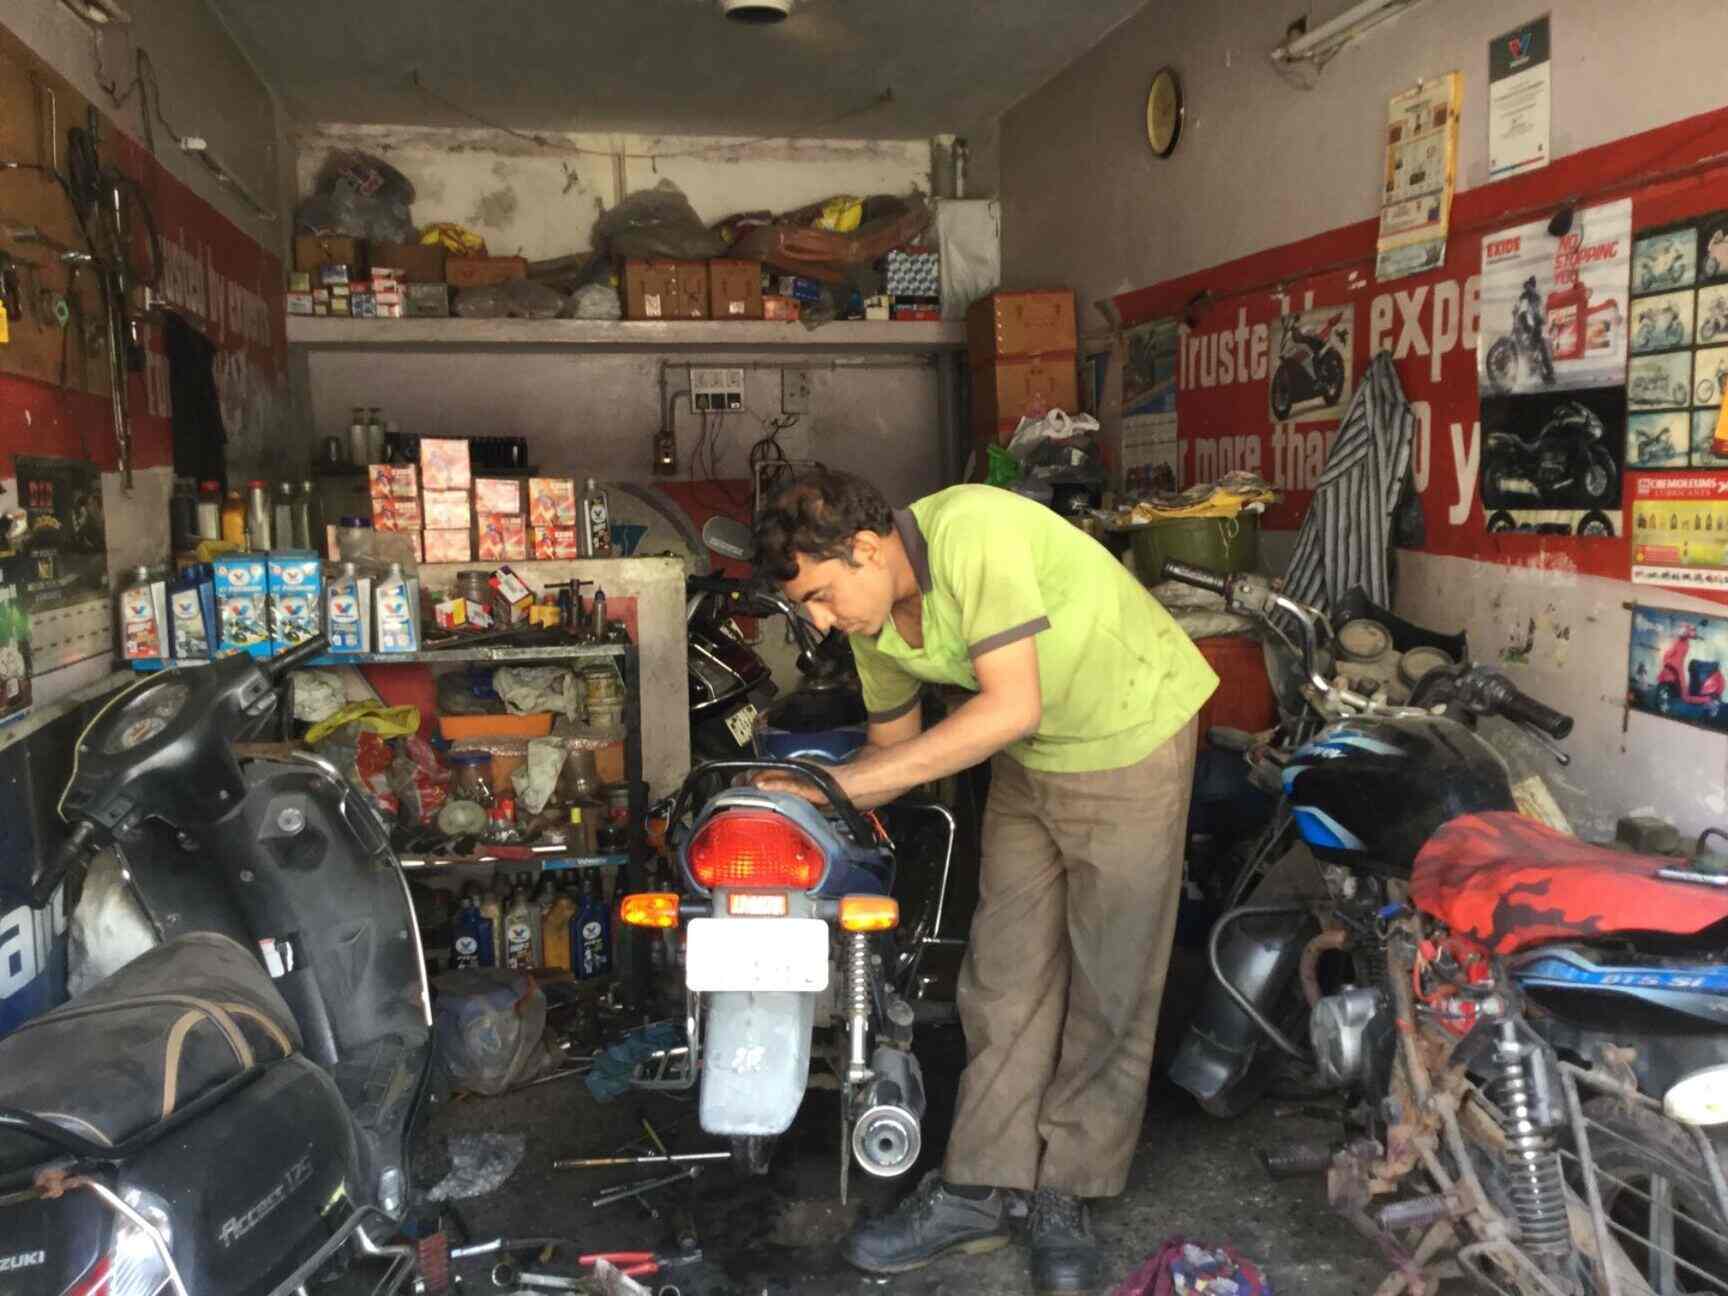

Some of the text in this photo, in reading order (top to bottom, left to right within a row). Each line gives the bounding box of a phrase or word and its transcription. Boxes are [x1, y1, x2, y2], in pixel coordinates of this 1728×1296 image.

[1487, 236, 1521, 257] EXIDE
[1178, 273, 1482, 390] Truste expe
[0, 1248, 46, 1272] ZUKI
